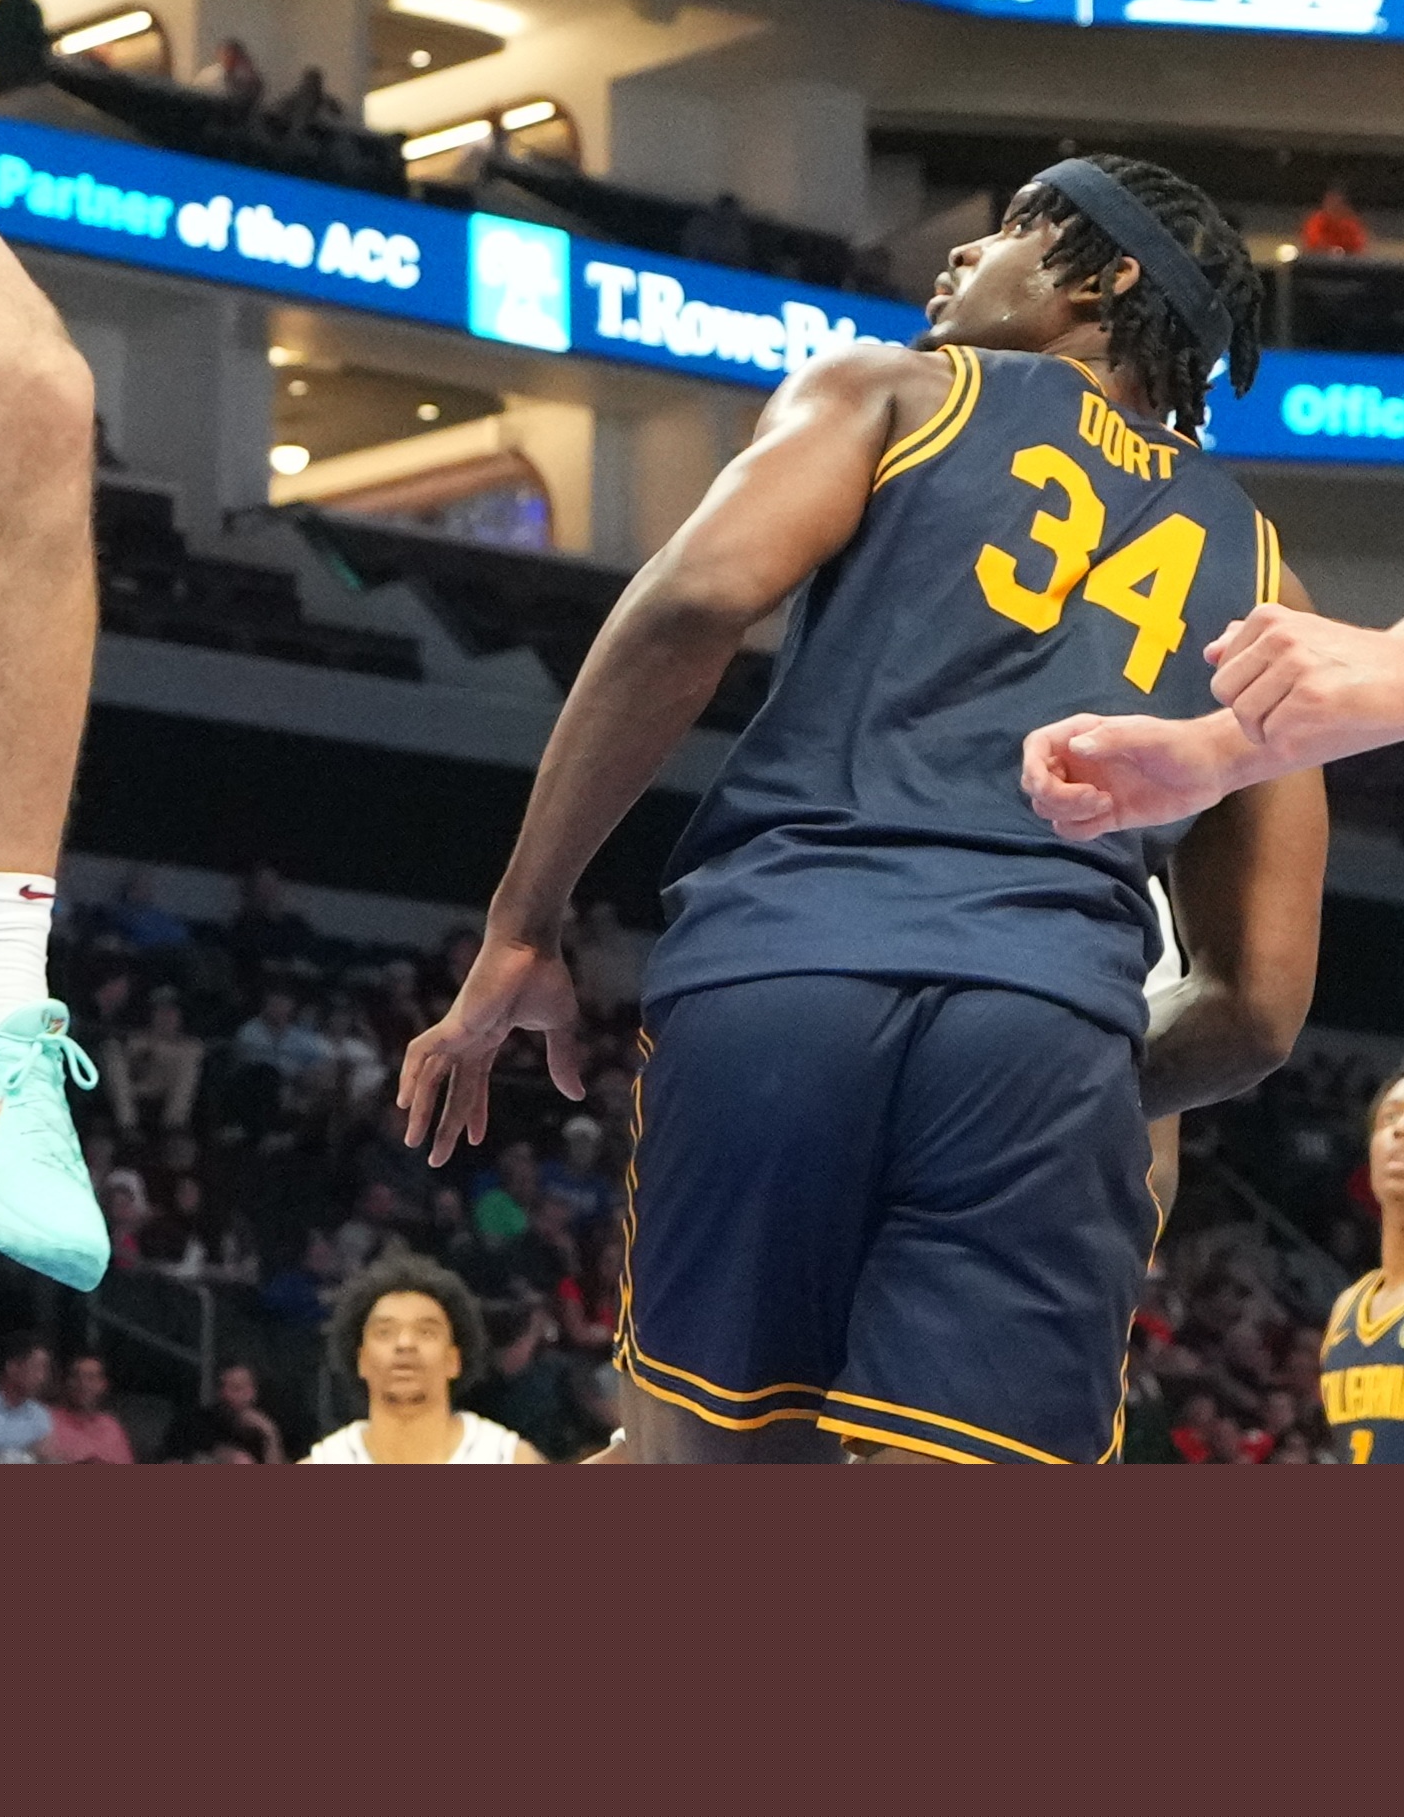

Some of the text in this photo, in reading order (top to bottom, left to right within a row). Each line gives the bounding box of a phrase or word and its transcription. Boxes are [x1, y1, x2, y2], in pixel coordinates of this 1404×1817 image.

[176, 196, 232, 250] of
[235, 207, 314, 270] the
[317, 221, 421, 288] ACC
[1078, 390, 1179, 481] DORT
[974, 444, 1207, 694] 34
